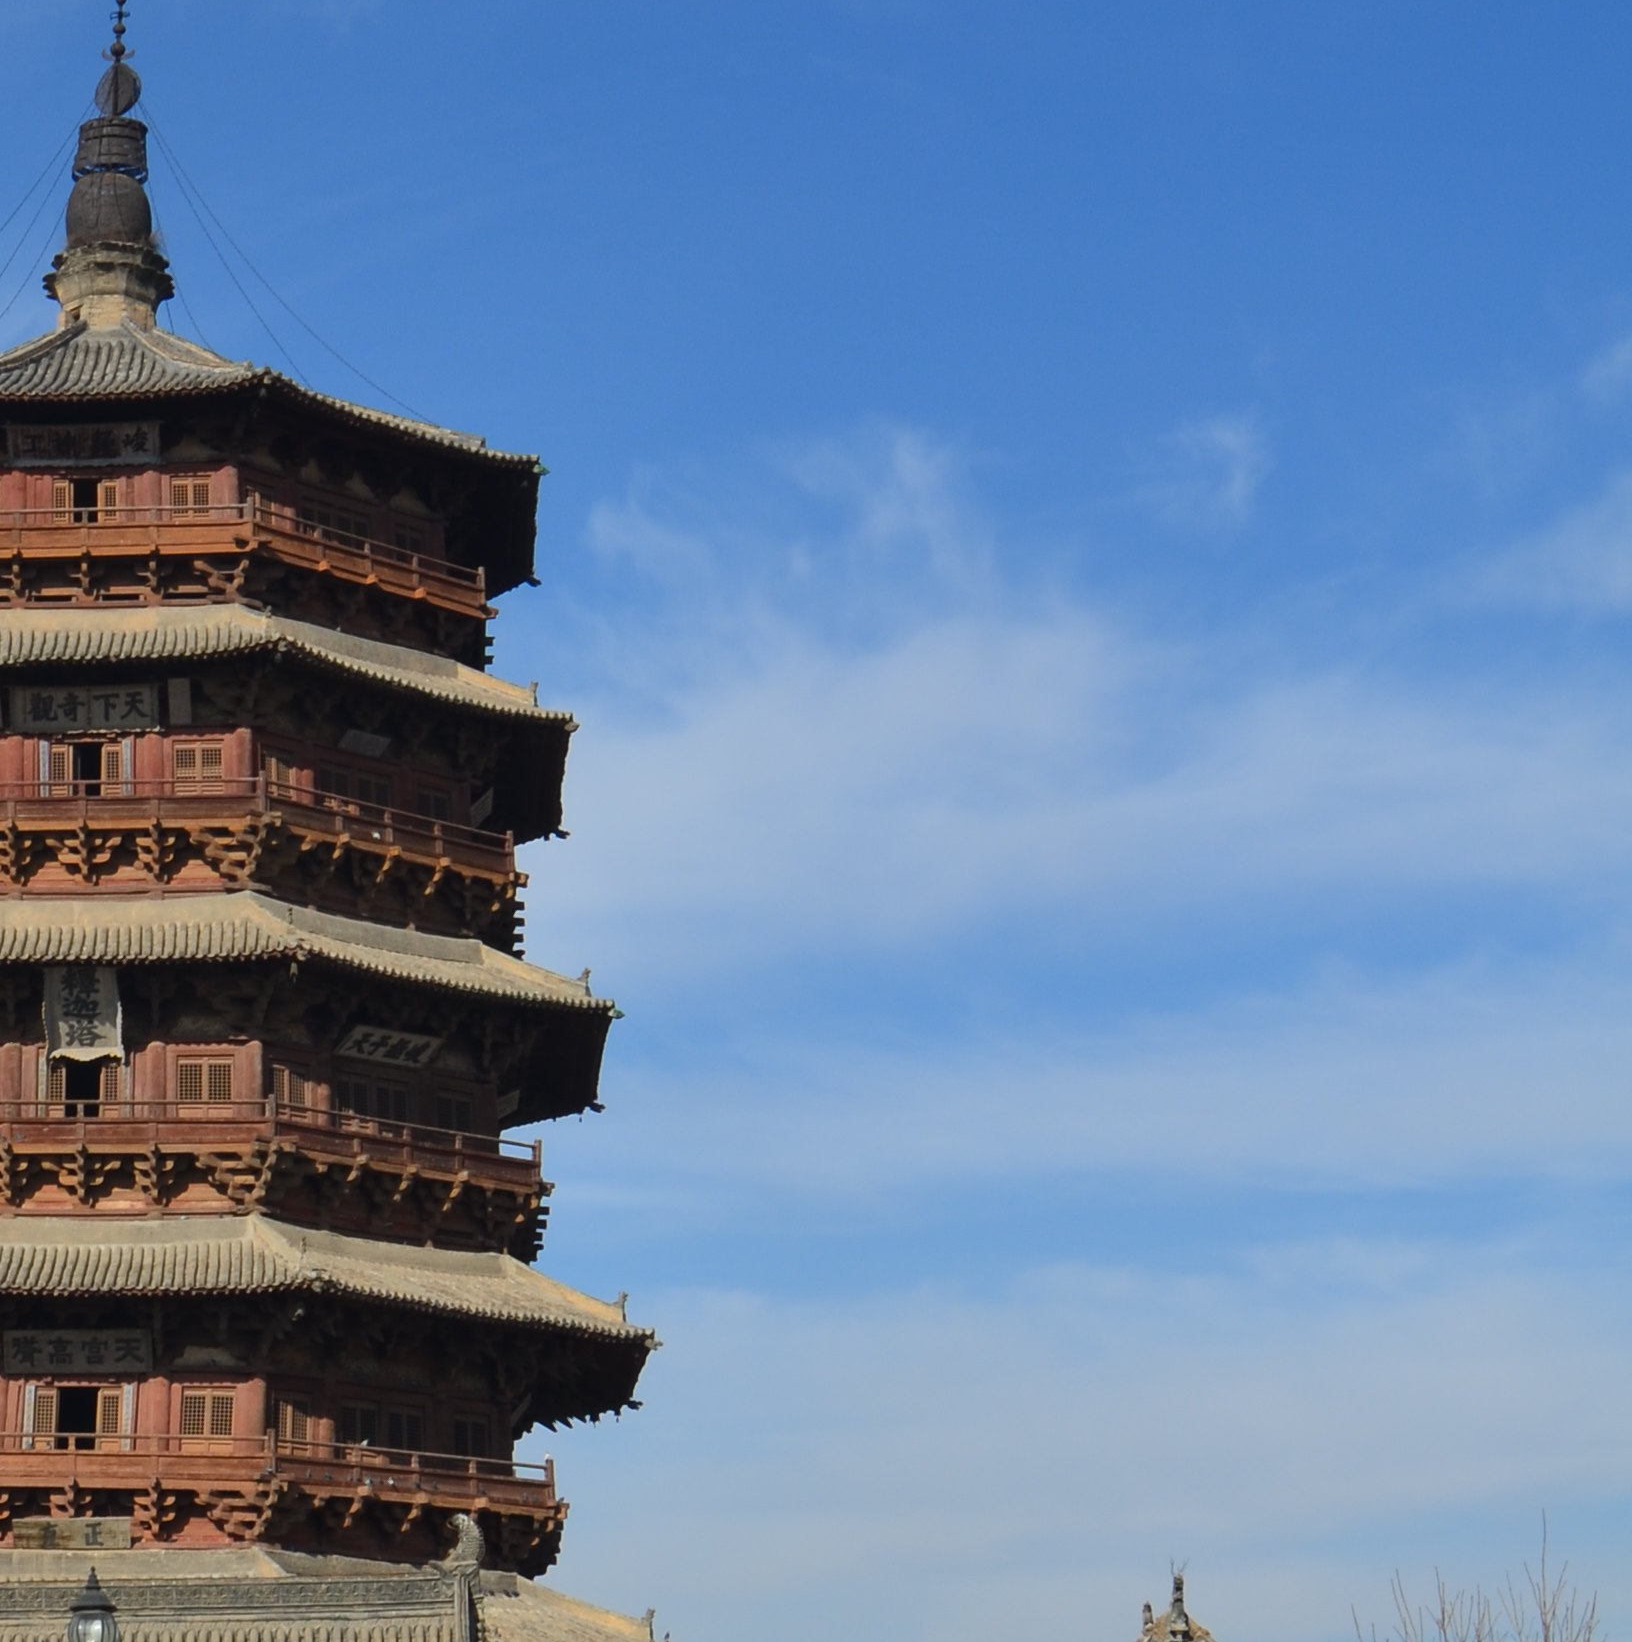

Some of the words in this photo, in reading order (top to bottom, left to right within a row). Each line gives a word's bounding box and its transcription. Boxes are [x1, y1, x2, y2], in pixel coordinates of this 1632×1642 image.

[28, 691, 150, 722] 天下奇觀
[60, 966, 106, 1047] 釋迦塔
